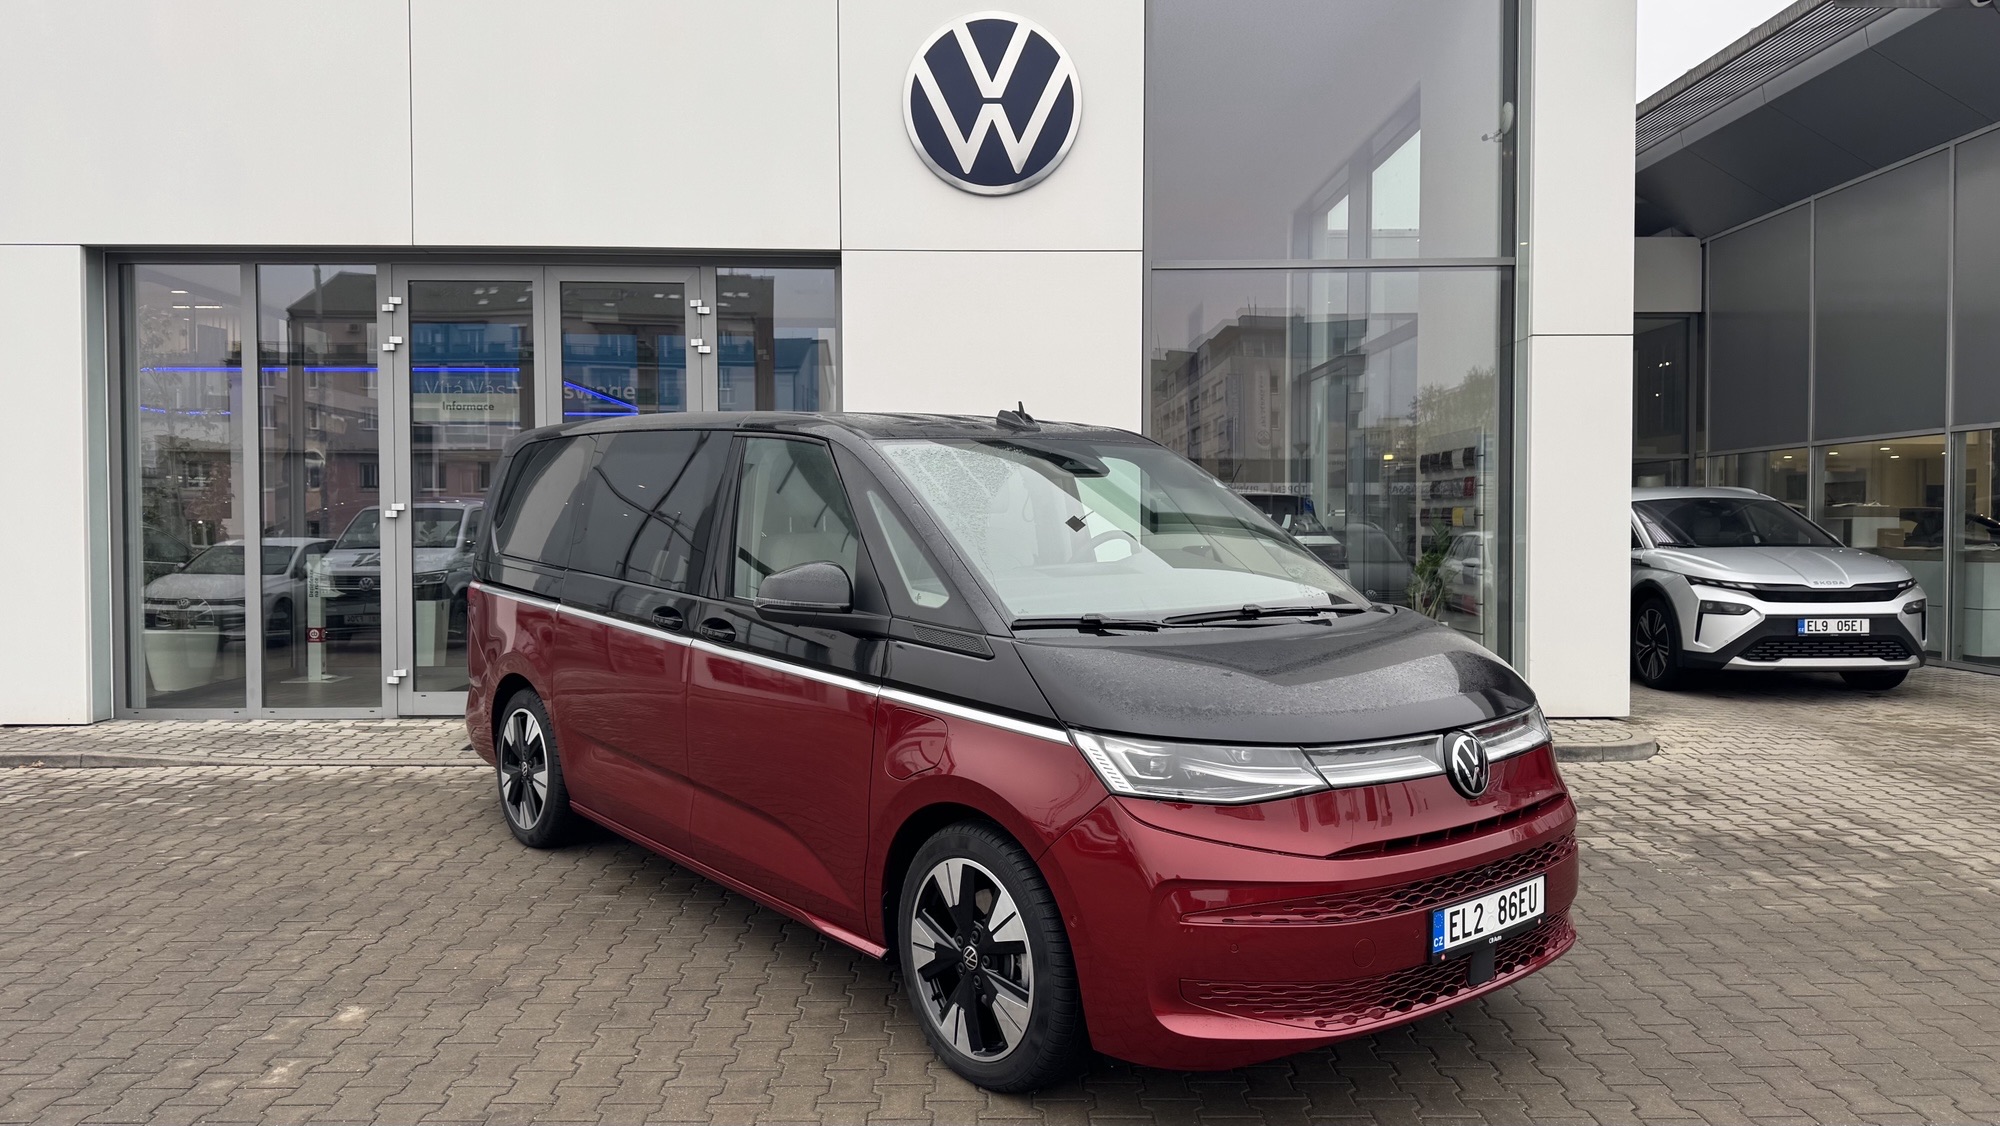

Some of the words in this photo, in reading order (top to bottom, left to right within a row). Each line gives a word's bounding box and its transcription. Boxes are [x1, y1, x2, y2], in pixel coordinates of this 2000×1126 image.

[442, 400, 495, 411] Informace
[1807, 620, 1829, 632] EL9
[1837, 620, 1863, 632] 05EI
[1449, 902, 1484, 943] EL2
[1497, 882, 1538, 925] 86EU
[1433, 937, 1443, 948] CZ
